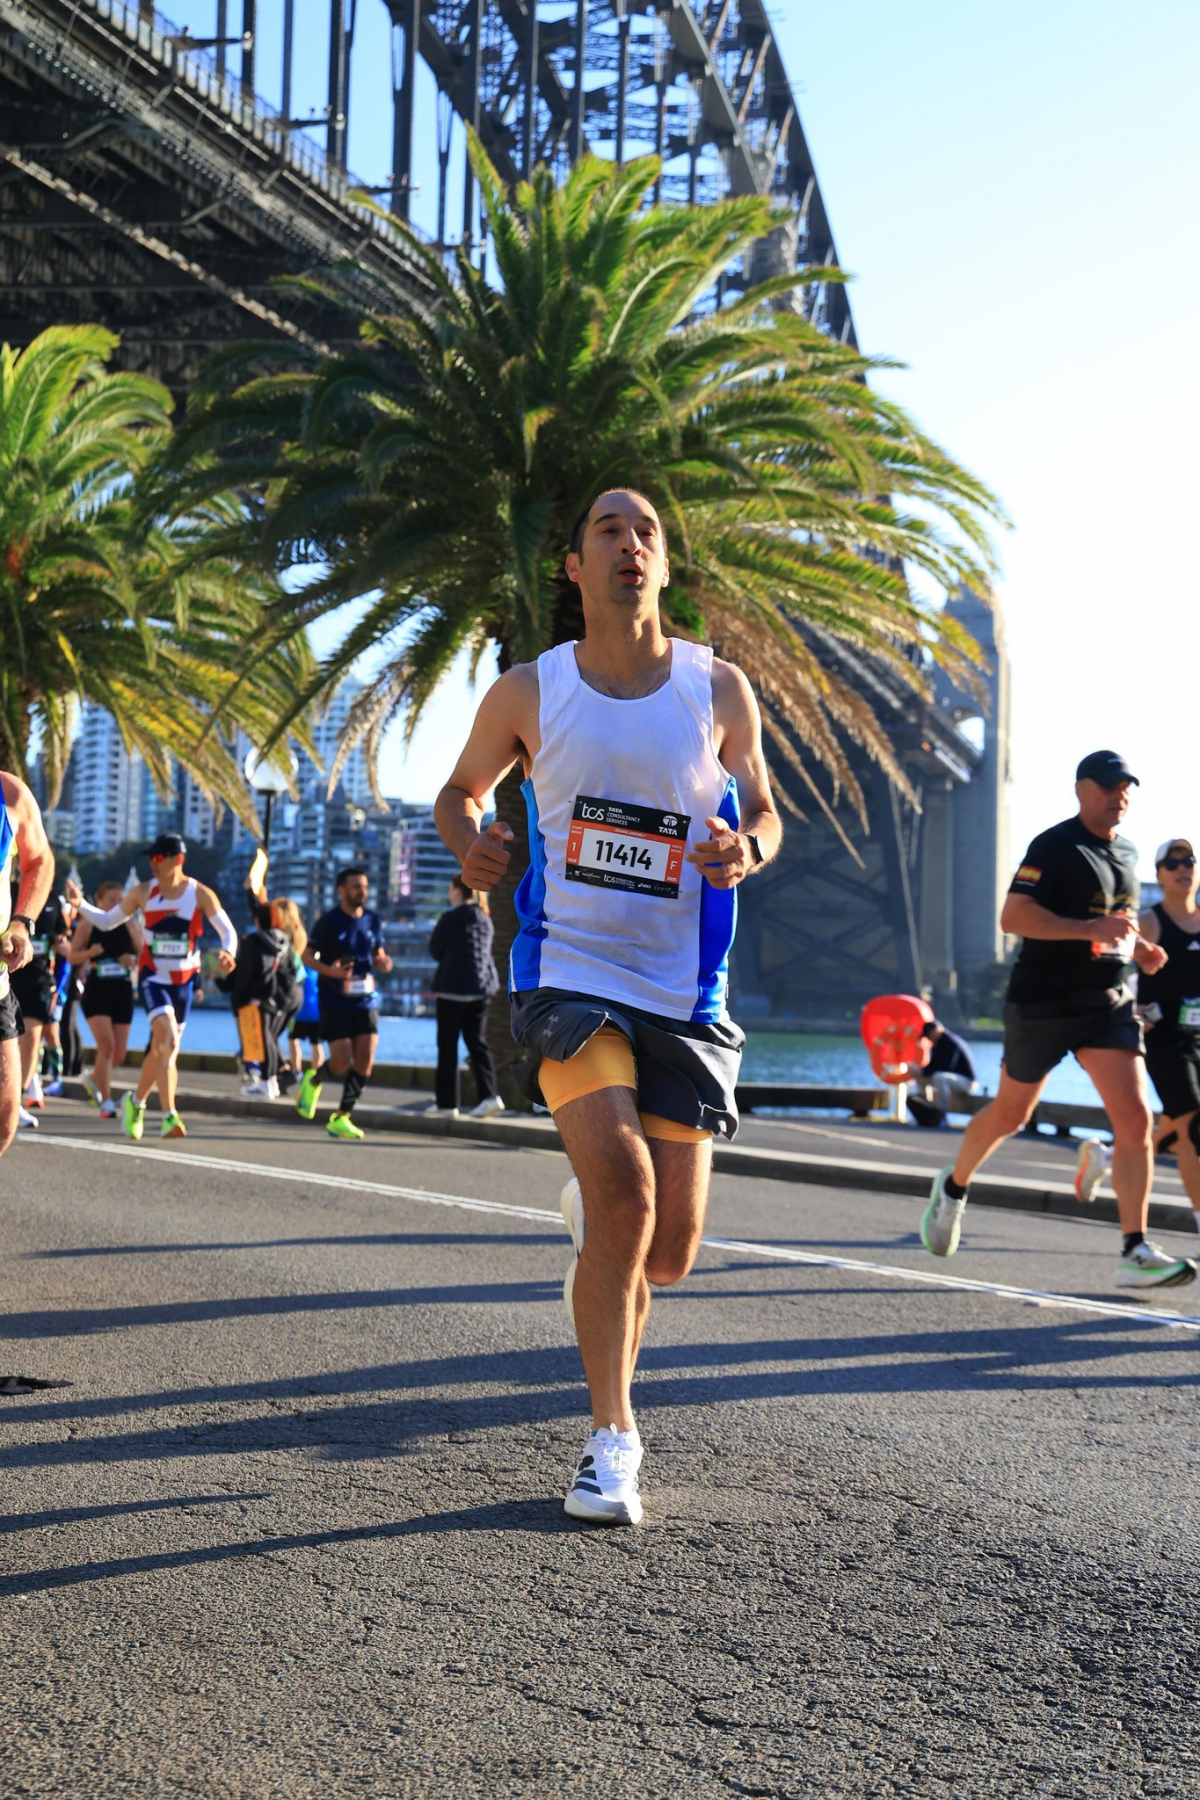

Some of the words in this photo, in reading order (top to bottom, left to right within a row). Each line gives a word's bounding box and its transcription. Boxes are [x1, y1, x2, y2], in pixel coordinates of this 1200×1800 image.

[608, 806, 623, 814] TATA
[605, 817, 628, 826] SERVICES
[606, 812, 641, 823] CONSULTANCY
[658, 826, 678, 836] TATA
[572, 841, 576, 852] 1
[595, 839, 652, 871] 11414
[670, 860, 678, 870] F
